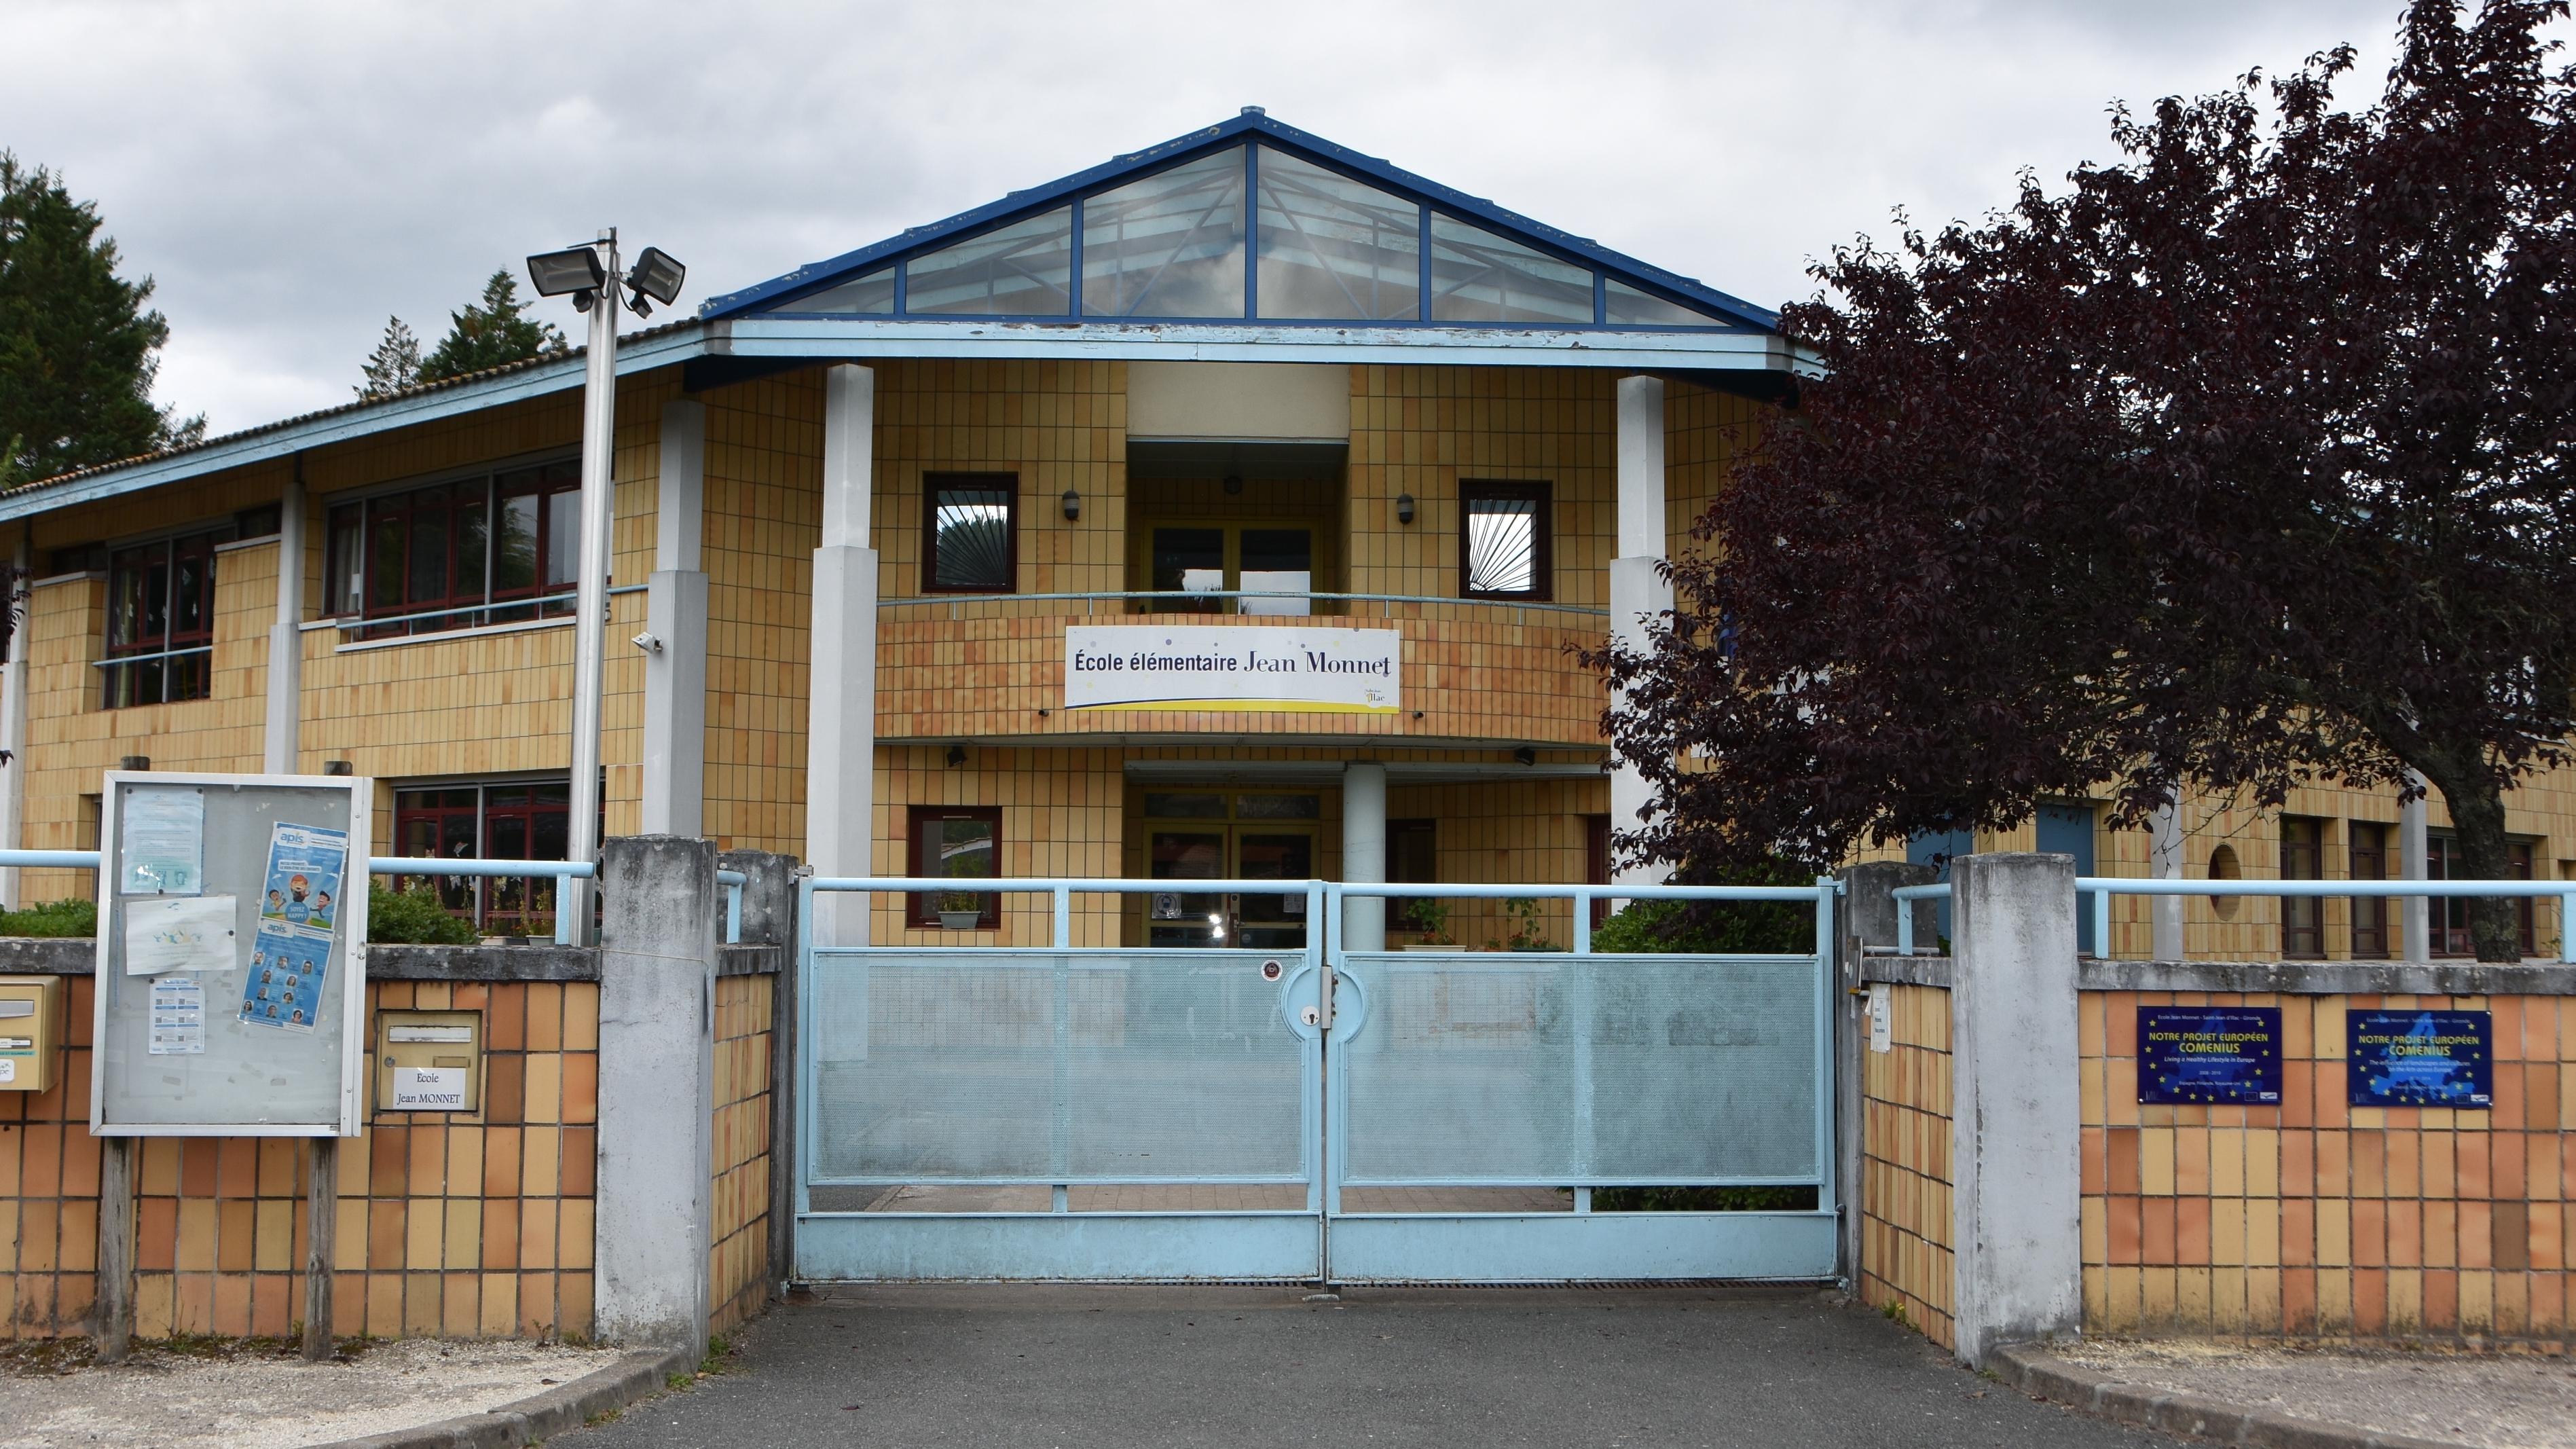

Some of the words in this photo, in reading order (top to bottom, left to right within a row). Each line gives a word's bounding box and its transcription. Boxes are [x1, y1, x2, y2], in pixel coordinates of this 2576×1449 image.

[1075, 649, 1123, 671] École
[1130, 653, 1237, 671] élémentaire
[1244, 650, 1297, 672] Jean
[1304, 651, 1391, 675] Monnet
[280, 832, 304, 844] apis
[268, 923, 287, 932] apis
[2149, 1032, 2179, 1041] NOTRE
[2183, 1033, 2216, 1042] PROJET
[2219, 1031, 2268, 1042] EUROPÉEN
[2359, 1035, 2389, 1044] NOTRE
[2393, 1035, 2427, 1044] PROJET
[2430, 1034, 2479, 1045] EUROPÉEN
[2179, 1042, 2240, 1053] COMENIUS
[2389, 1046, 2451, 1056] COMENIUS
[417, 1073, 439, 1083] Ecole
[397, 1094, 416, 1105] Jean
[418, 1094, 460, 1103] MONNET
